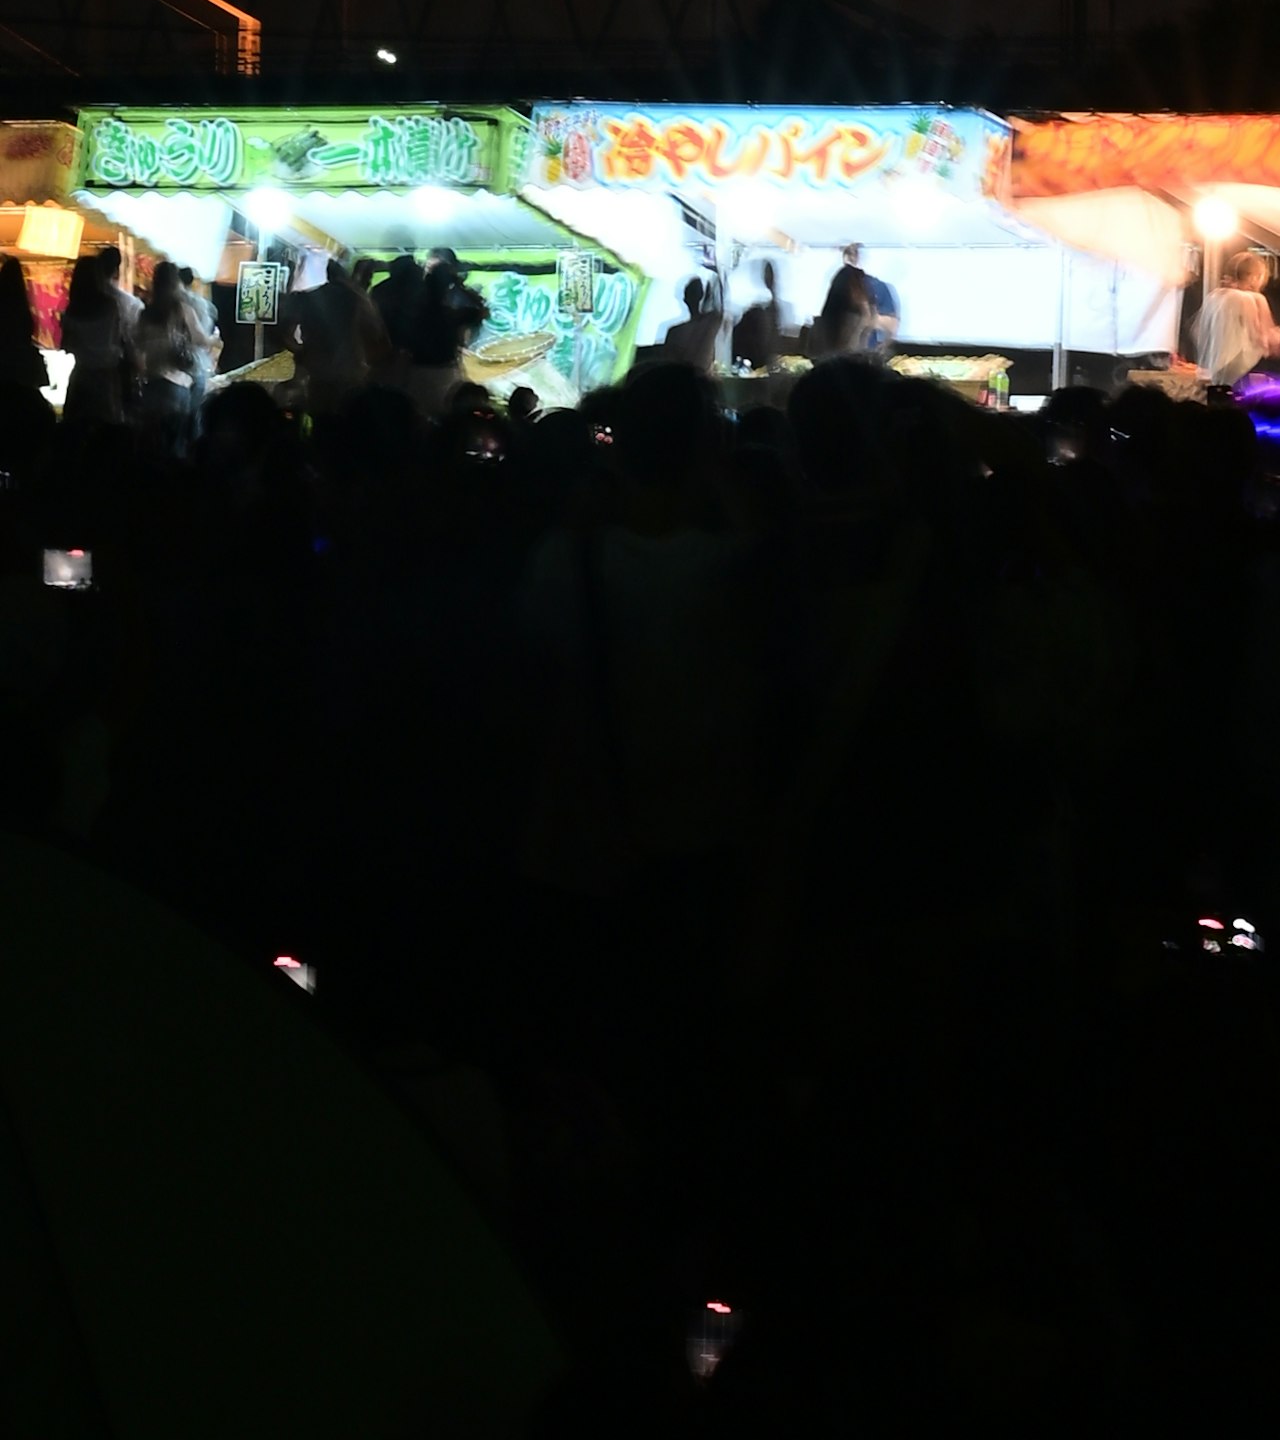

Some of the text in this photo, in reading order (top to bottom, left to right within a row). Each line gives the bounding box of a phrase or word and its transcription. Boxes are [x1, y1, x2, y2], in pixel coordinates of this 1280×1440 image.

[93, 118, 243, 188] きゅうり
[602, 115, 889, 181] 冷やしパイン
